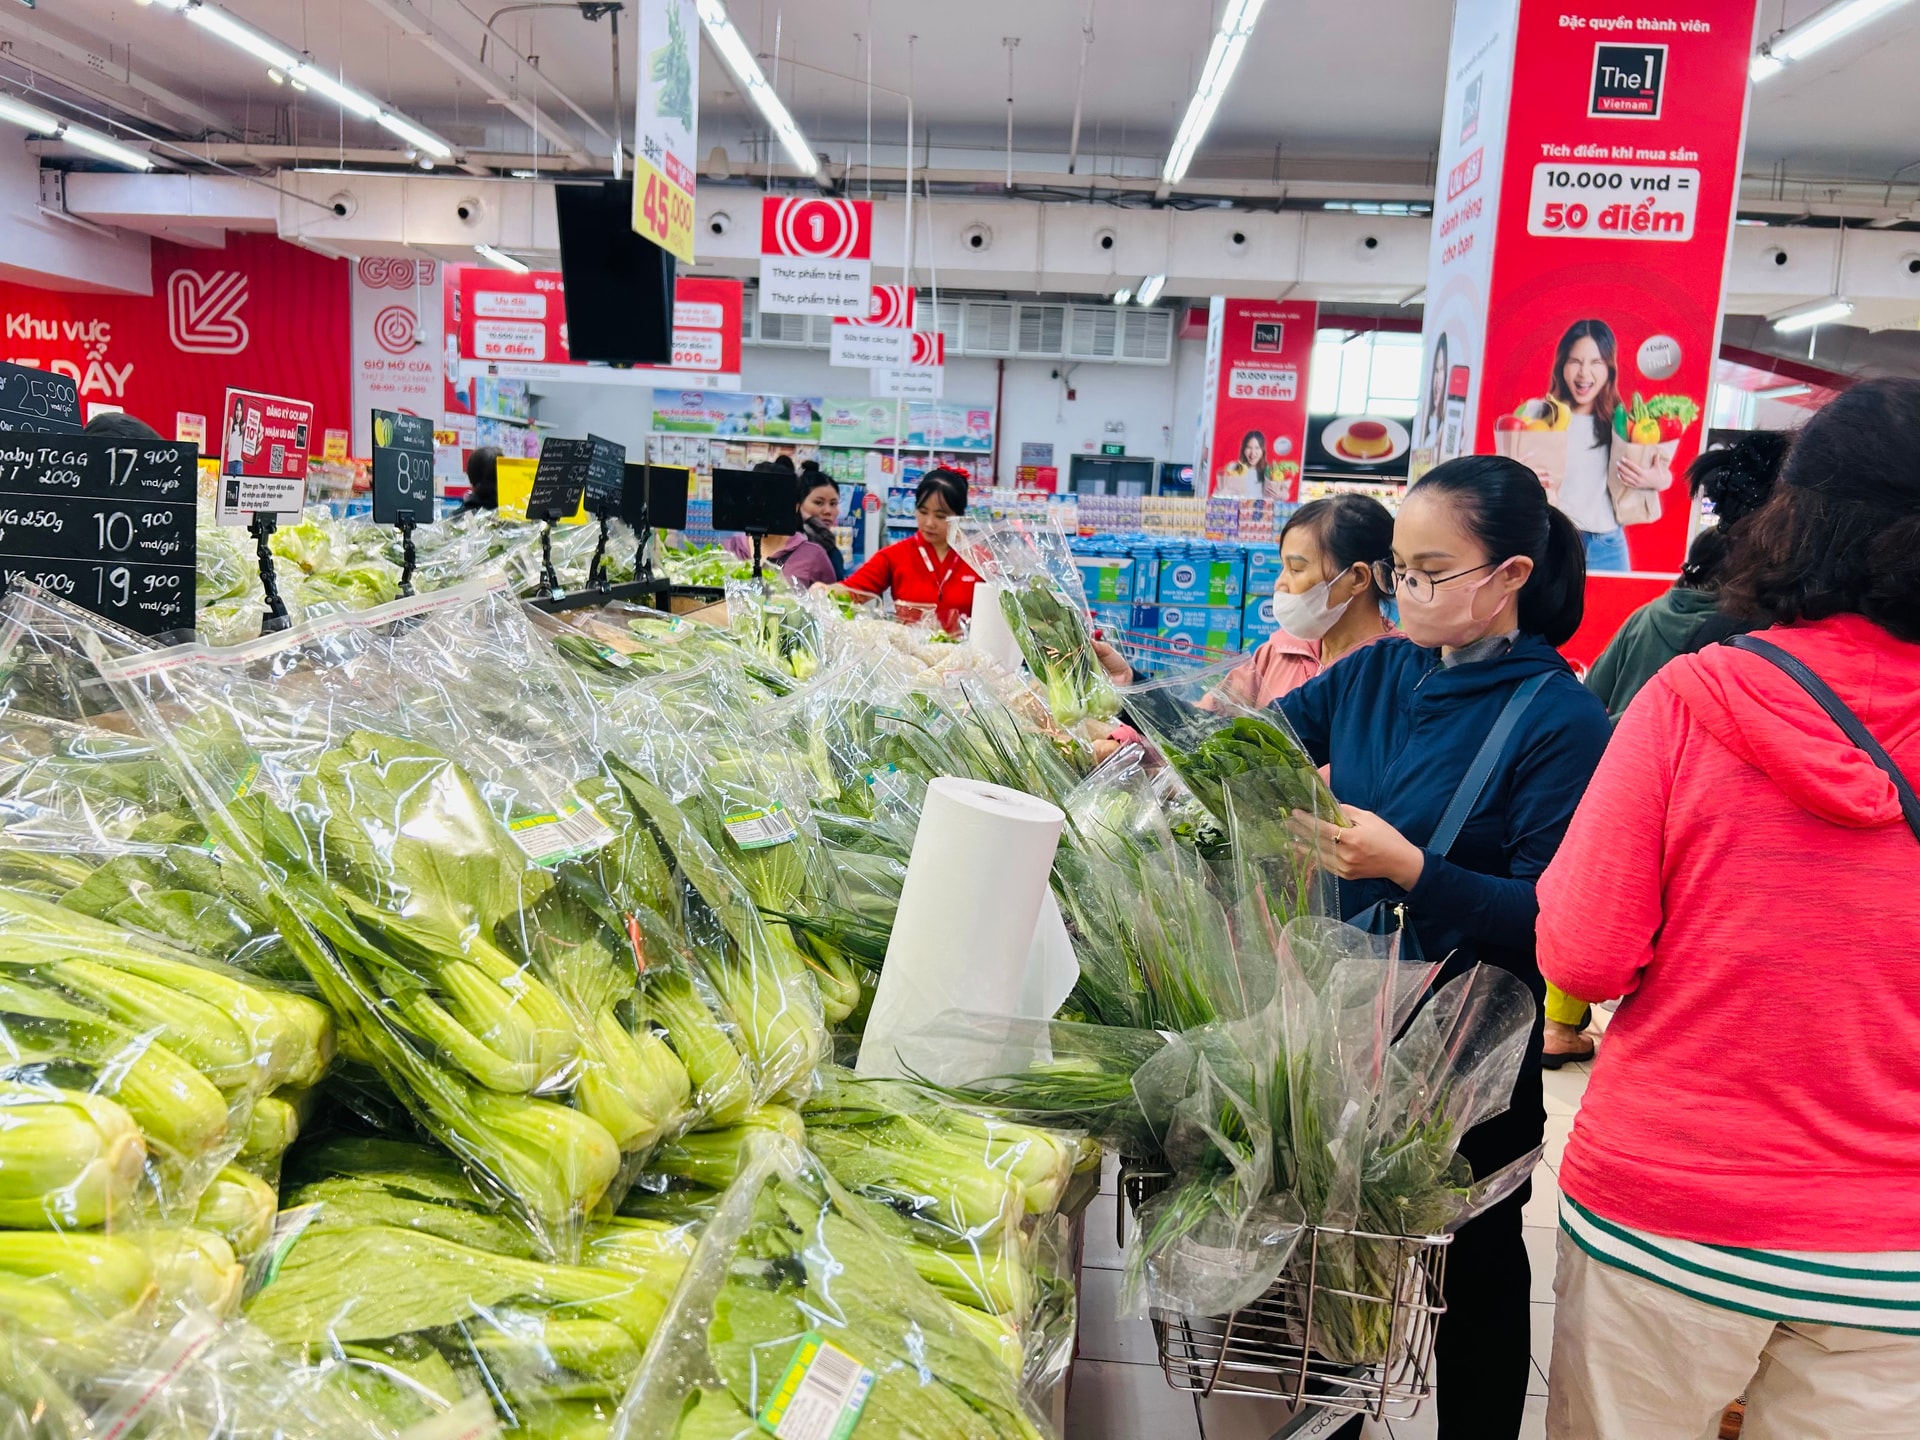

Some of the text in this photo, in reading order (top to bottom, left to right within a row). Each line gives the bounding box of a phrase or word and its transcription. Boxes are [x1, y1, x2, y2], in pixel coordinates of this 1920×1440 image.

[1558, 15, 1711, 33] Đặc quyền thành viên
[1601, 66, 1641, 89] The
[1603, 99, 1648, 111] Vietnam
[1541, 144, 1699, 162] Tích điểm khi mua sắm
[1547, 171, 1622, 190] 10.000
[1630, 175, 1671, 191] vnd
[1541, 196, 1686, 234] 50 điểm
[809, 214, 824, 242] 1
[772, 267, 796, 279] Thực
[798, 267, 826, 280] phẩm
[844, 273, 859, 281] em
[771, 292, 795, 304] Thực
[797, 292, 825, 304] phẩm
[843, 298, 859, 306] em
[6, 312, 111, 349] Khu vực
[485, 341, 535, 356] 50 điểm
[1236, 371, 1267, 380] 10.000
[1235, 382, 1291, 397] 50 điểm
[39, 469, 81, 488] 200g
[20, 510, 64, 533] 250g
[35, 572, 76, 594] 500g
